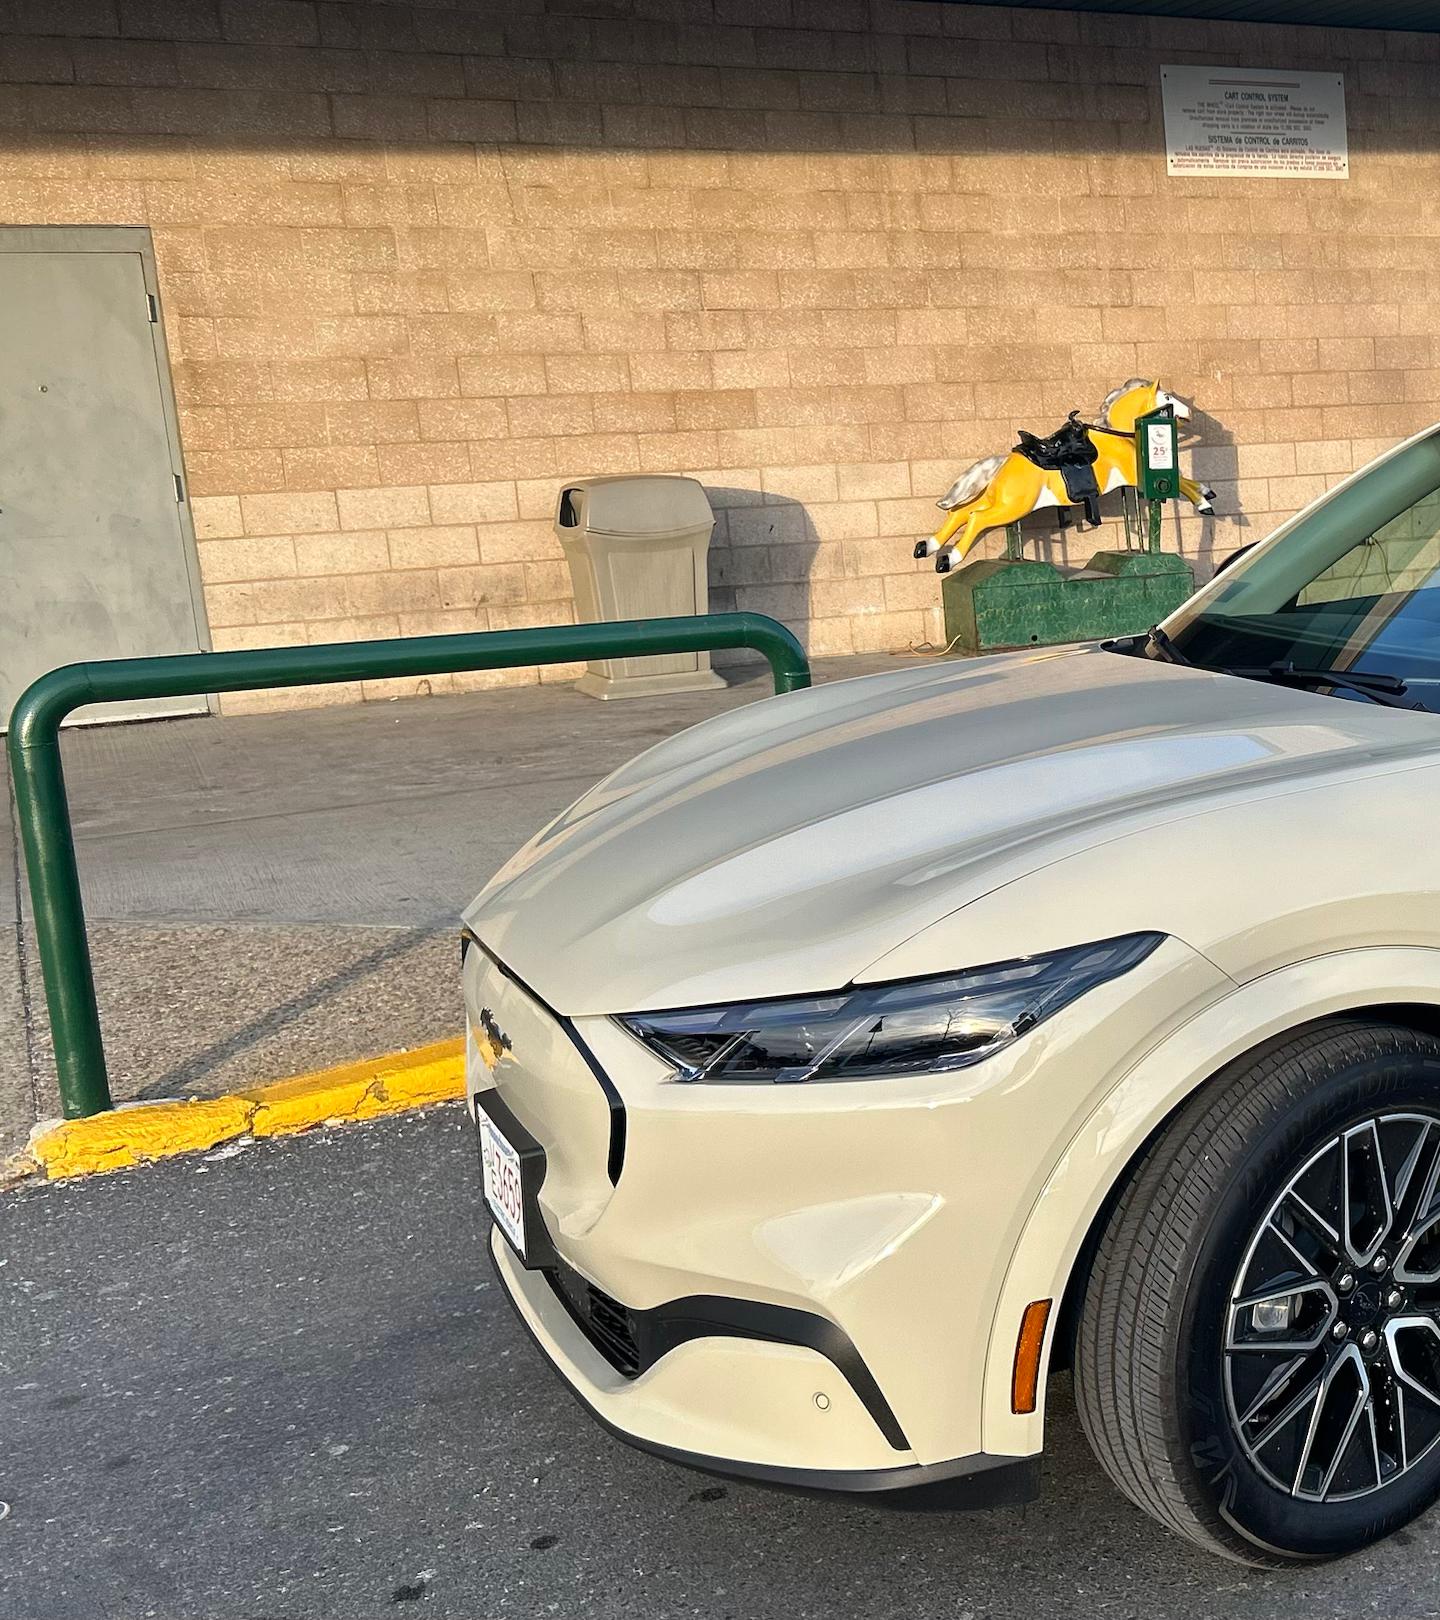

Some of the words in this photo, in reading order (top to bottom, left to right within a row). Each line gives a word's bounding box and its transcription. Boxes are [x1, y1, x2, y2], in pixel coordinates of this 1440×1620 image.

[1224, 90, 1239, 101] CART
[1240, 91, 1267, 102] CONTROL
[1267, 92, 1289, 103] SYSTEM
[1207, 135, 1233, 145] SISTEMA
[1234, 136, 1243, 145] de
[1244, 136, 1271, 146] CONTROL
[1272, 137, 1280, 146] de
[1281, 137, 1309, 147] CARRITOS
